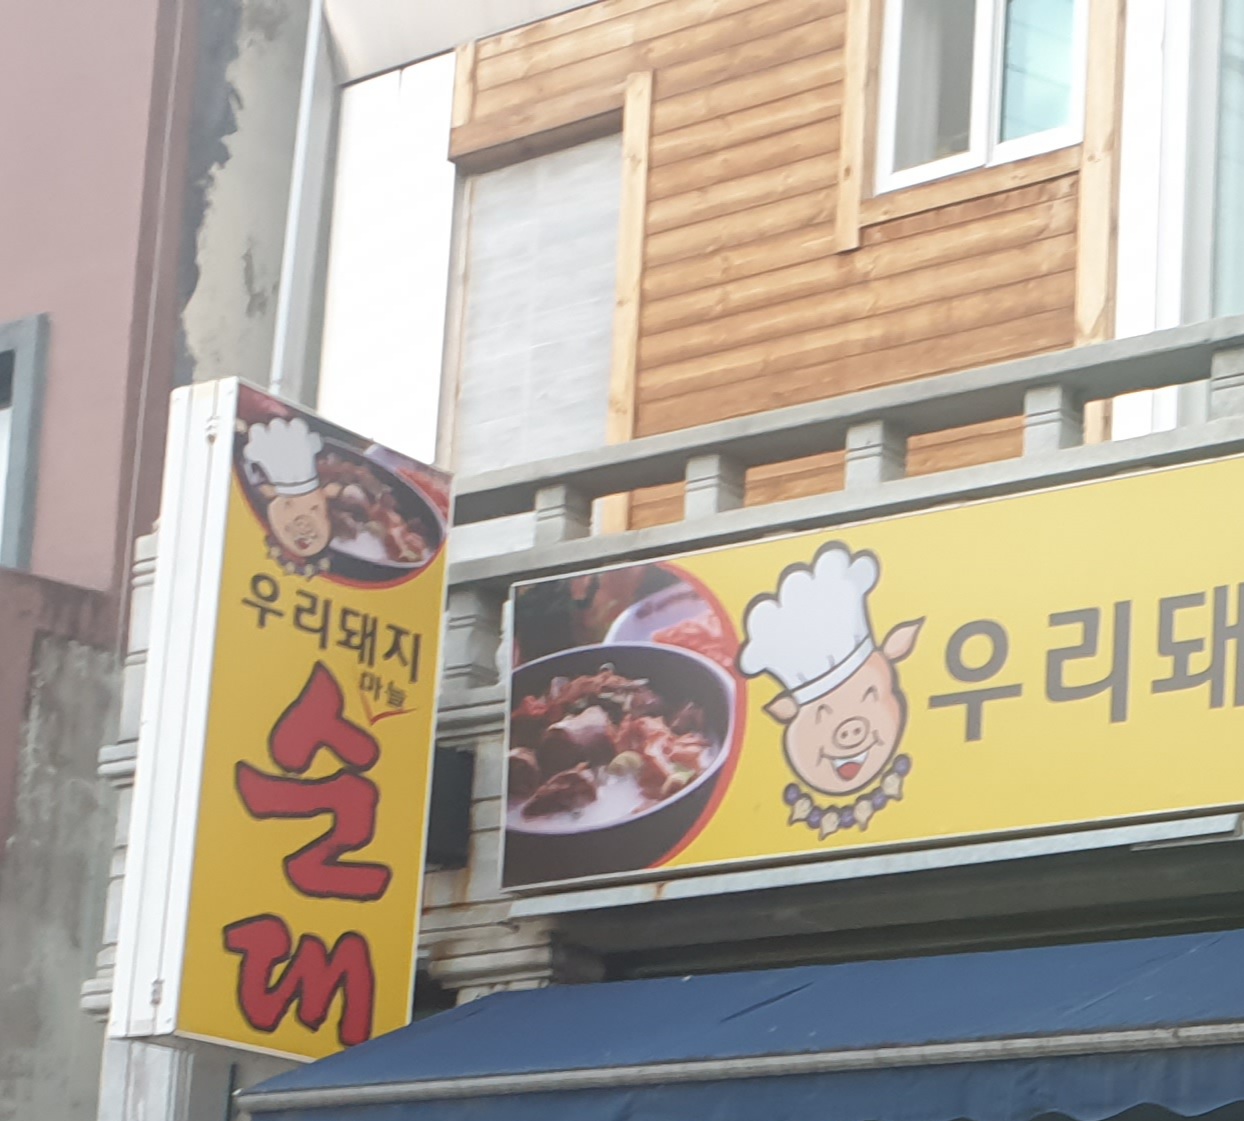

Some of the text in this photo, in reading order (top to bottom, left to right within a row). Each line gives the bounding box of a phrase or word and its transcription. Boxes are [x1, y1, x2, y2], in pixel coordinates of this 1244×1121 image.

[241, 572, 422, 684] 우리돼지
[359, 670, 408, 709] 마늘
[222, 659, 393, 1049] 순대
